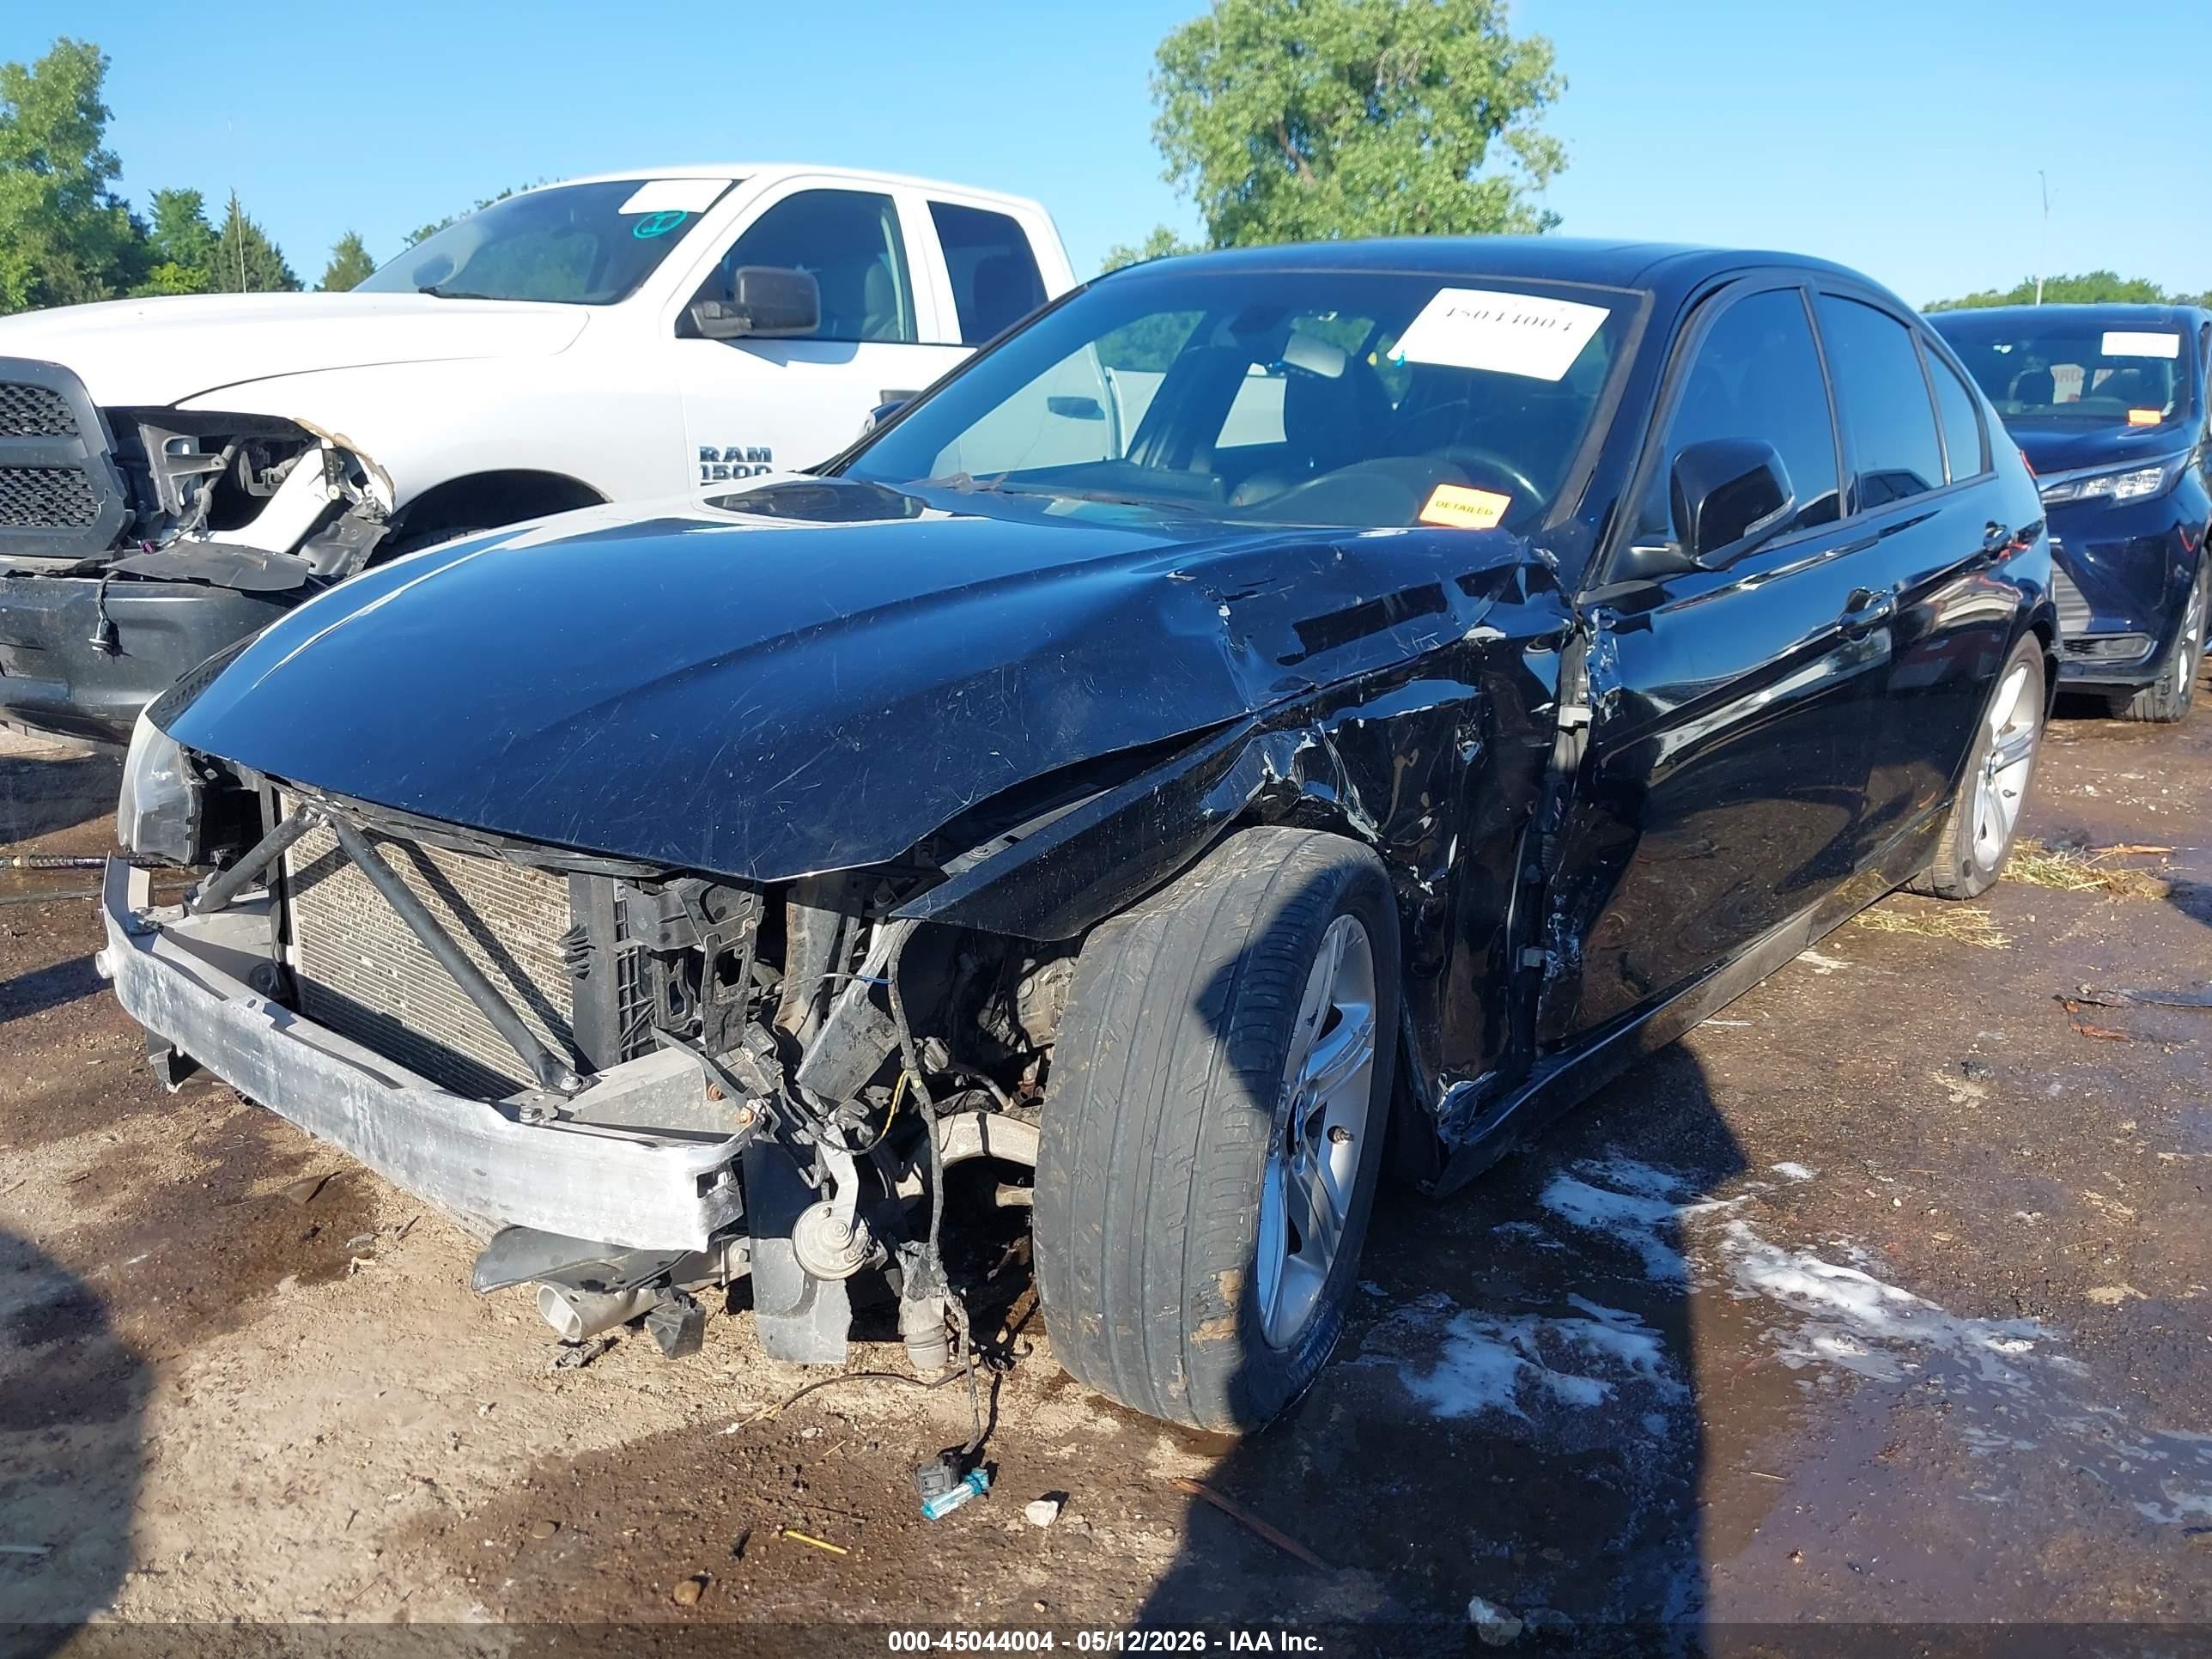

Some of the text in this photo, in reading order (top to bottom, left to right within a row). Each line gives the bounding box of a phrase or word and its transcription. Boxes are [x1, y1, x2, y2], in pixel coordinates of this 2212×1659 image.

[700, 447, 772, 462] RAM
[701, 464, 773, 480] 1500
[1435, 501, 1494, 516] DETAILED
